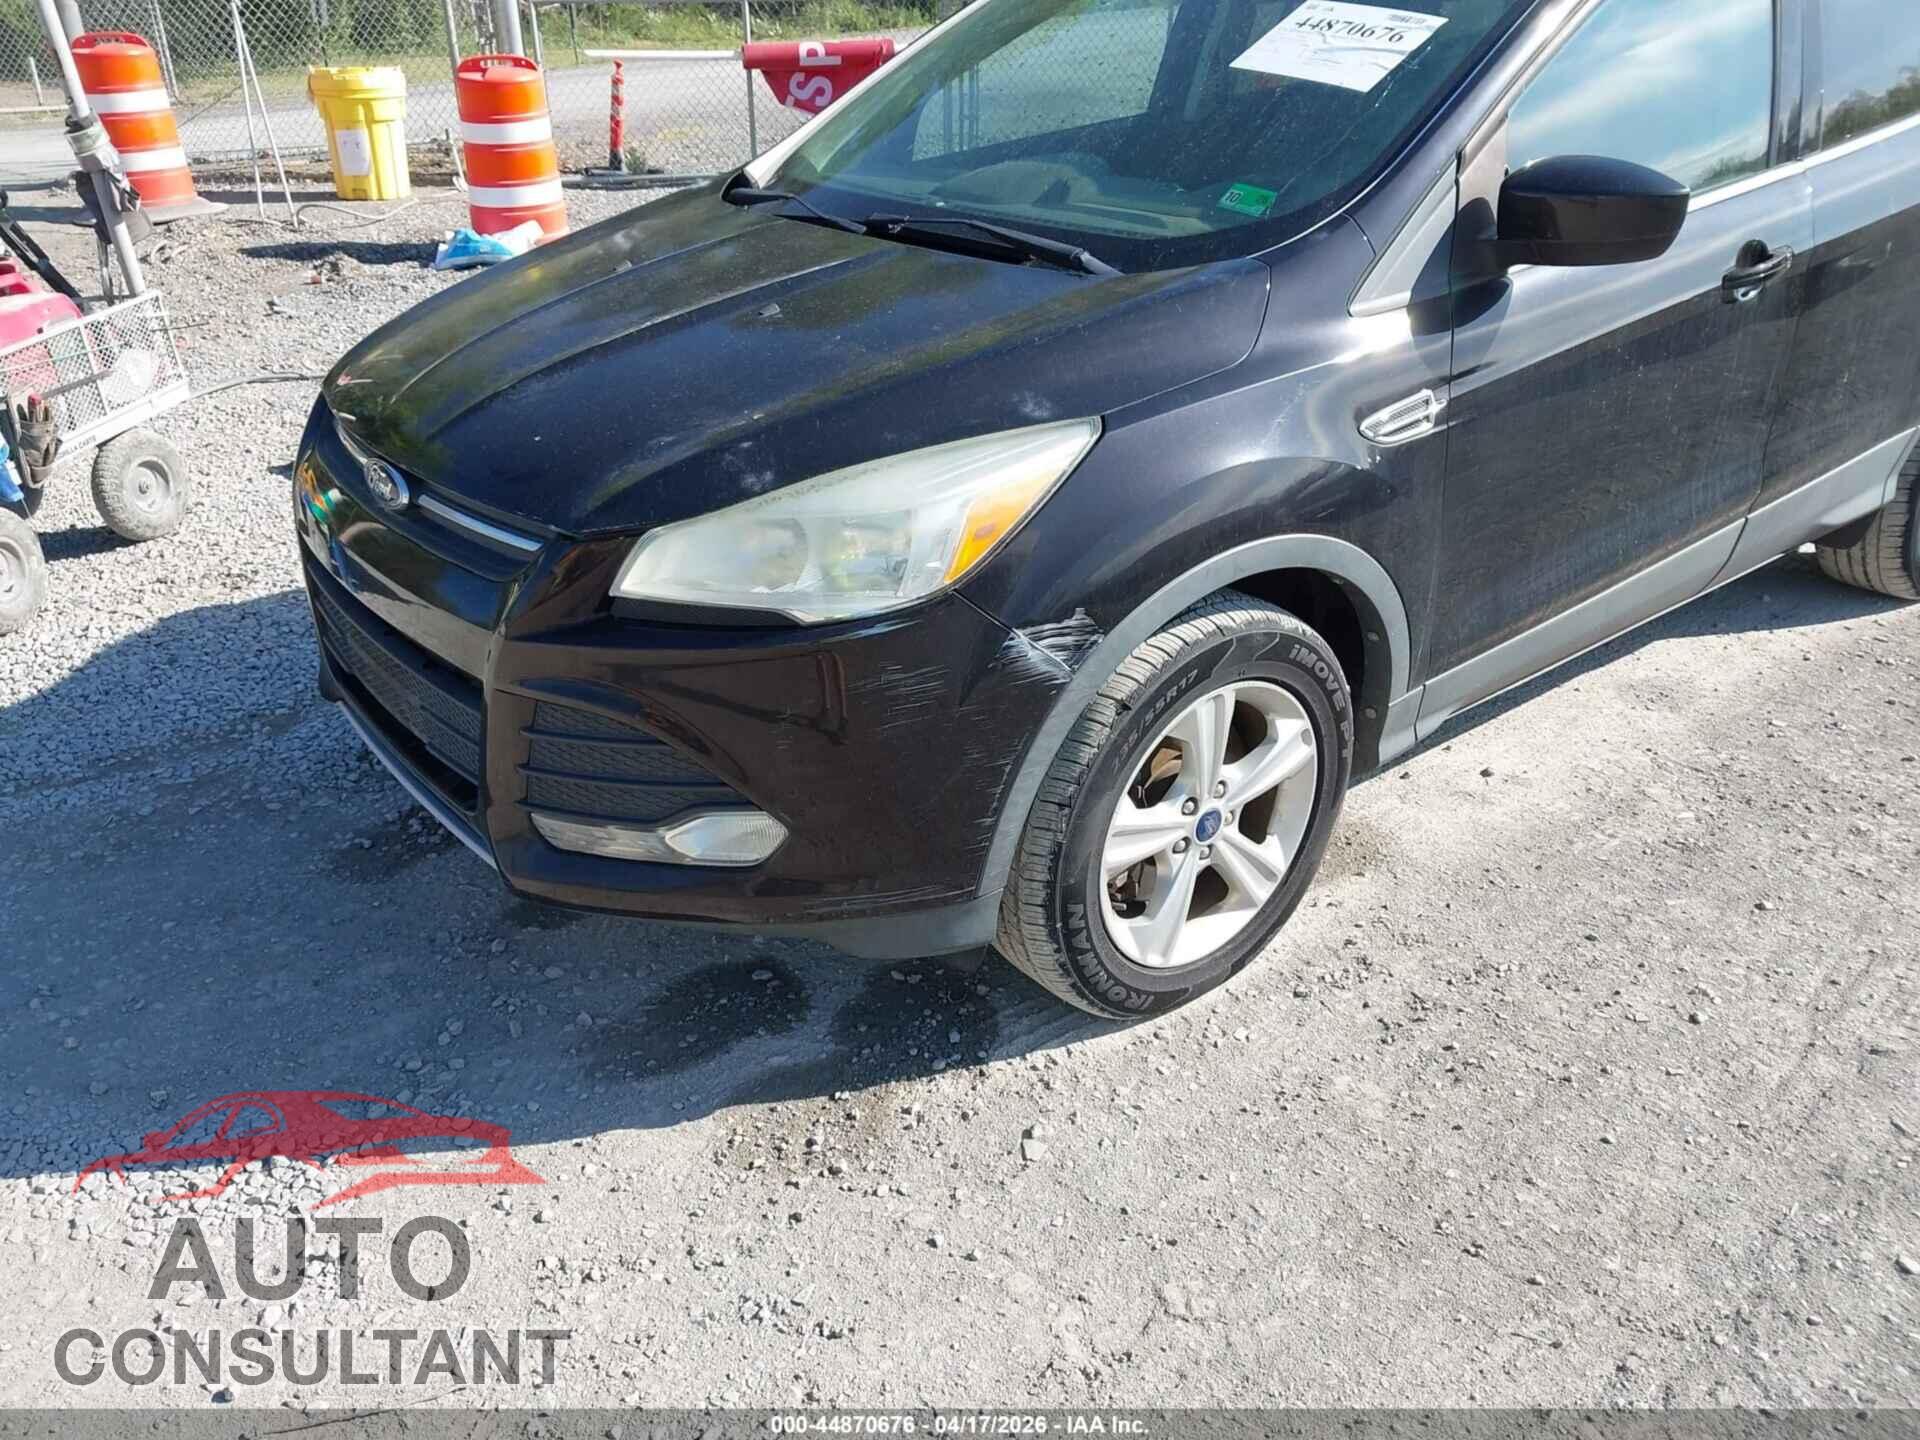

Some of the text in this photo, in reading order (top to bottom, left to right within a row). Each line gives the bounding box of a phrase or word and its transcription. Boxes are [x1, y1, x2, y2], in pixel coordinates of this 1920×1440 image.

[1295, 15, 1406, 44] 44870676
[368, 463, 395, 501] Ford
[1066, 903, 1155, 1010] IRONMAN
